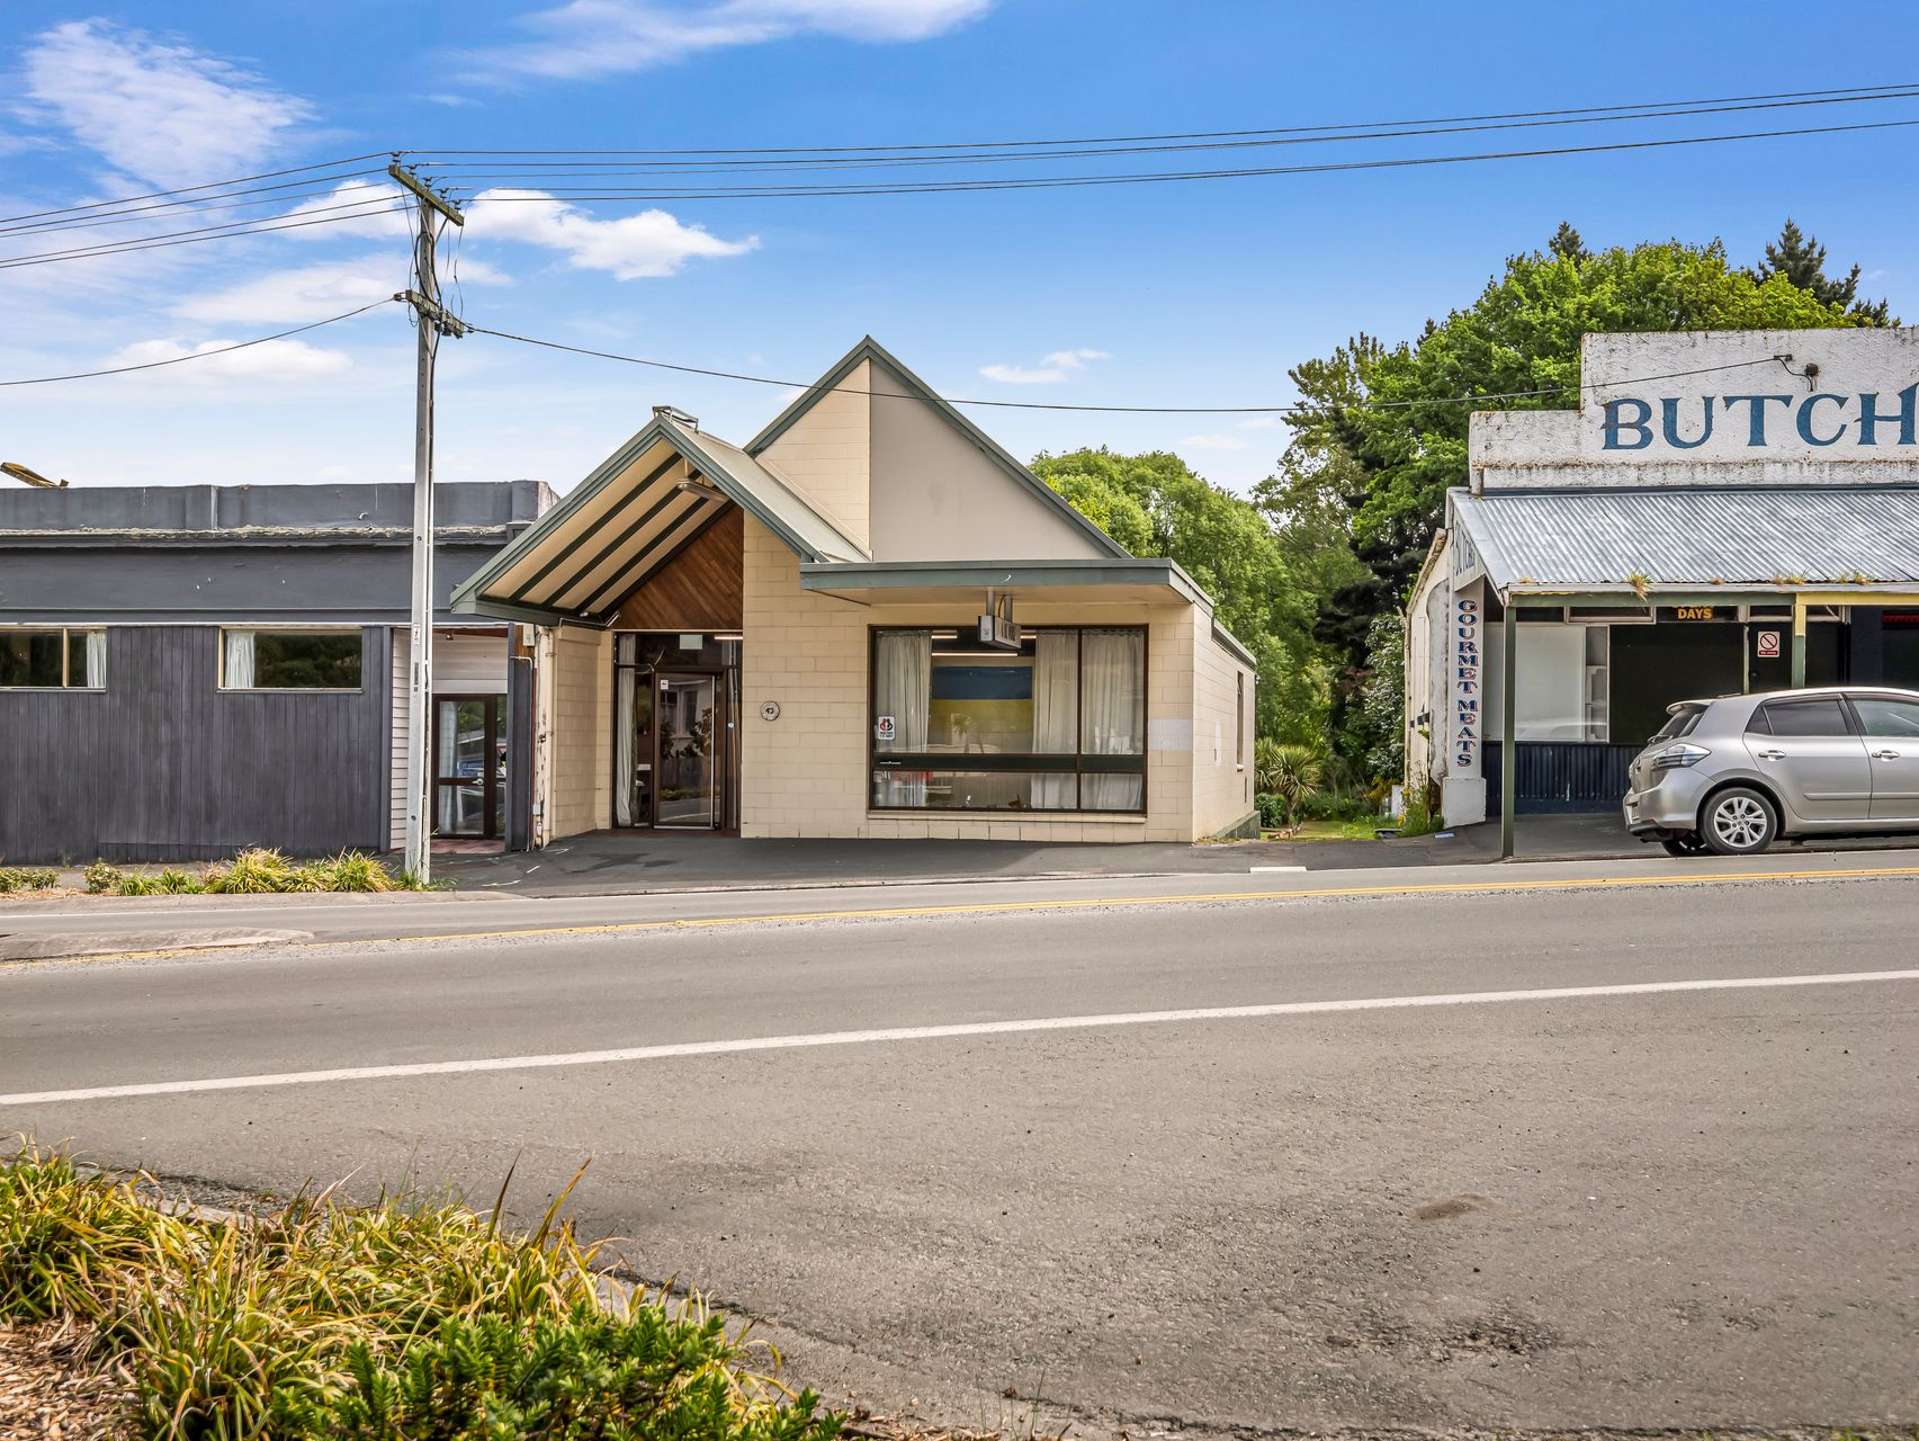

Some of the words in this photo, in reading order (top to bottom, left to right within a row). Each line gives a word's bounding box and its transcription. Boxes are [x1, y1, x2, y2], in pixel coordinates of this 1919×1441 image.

[1457, 599, 1479, 694] GOURMET
[1677, 607, 1713, 620] DAYS
[1456, 699, 1478, 768] MEATS
